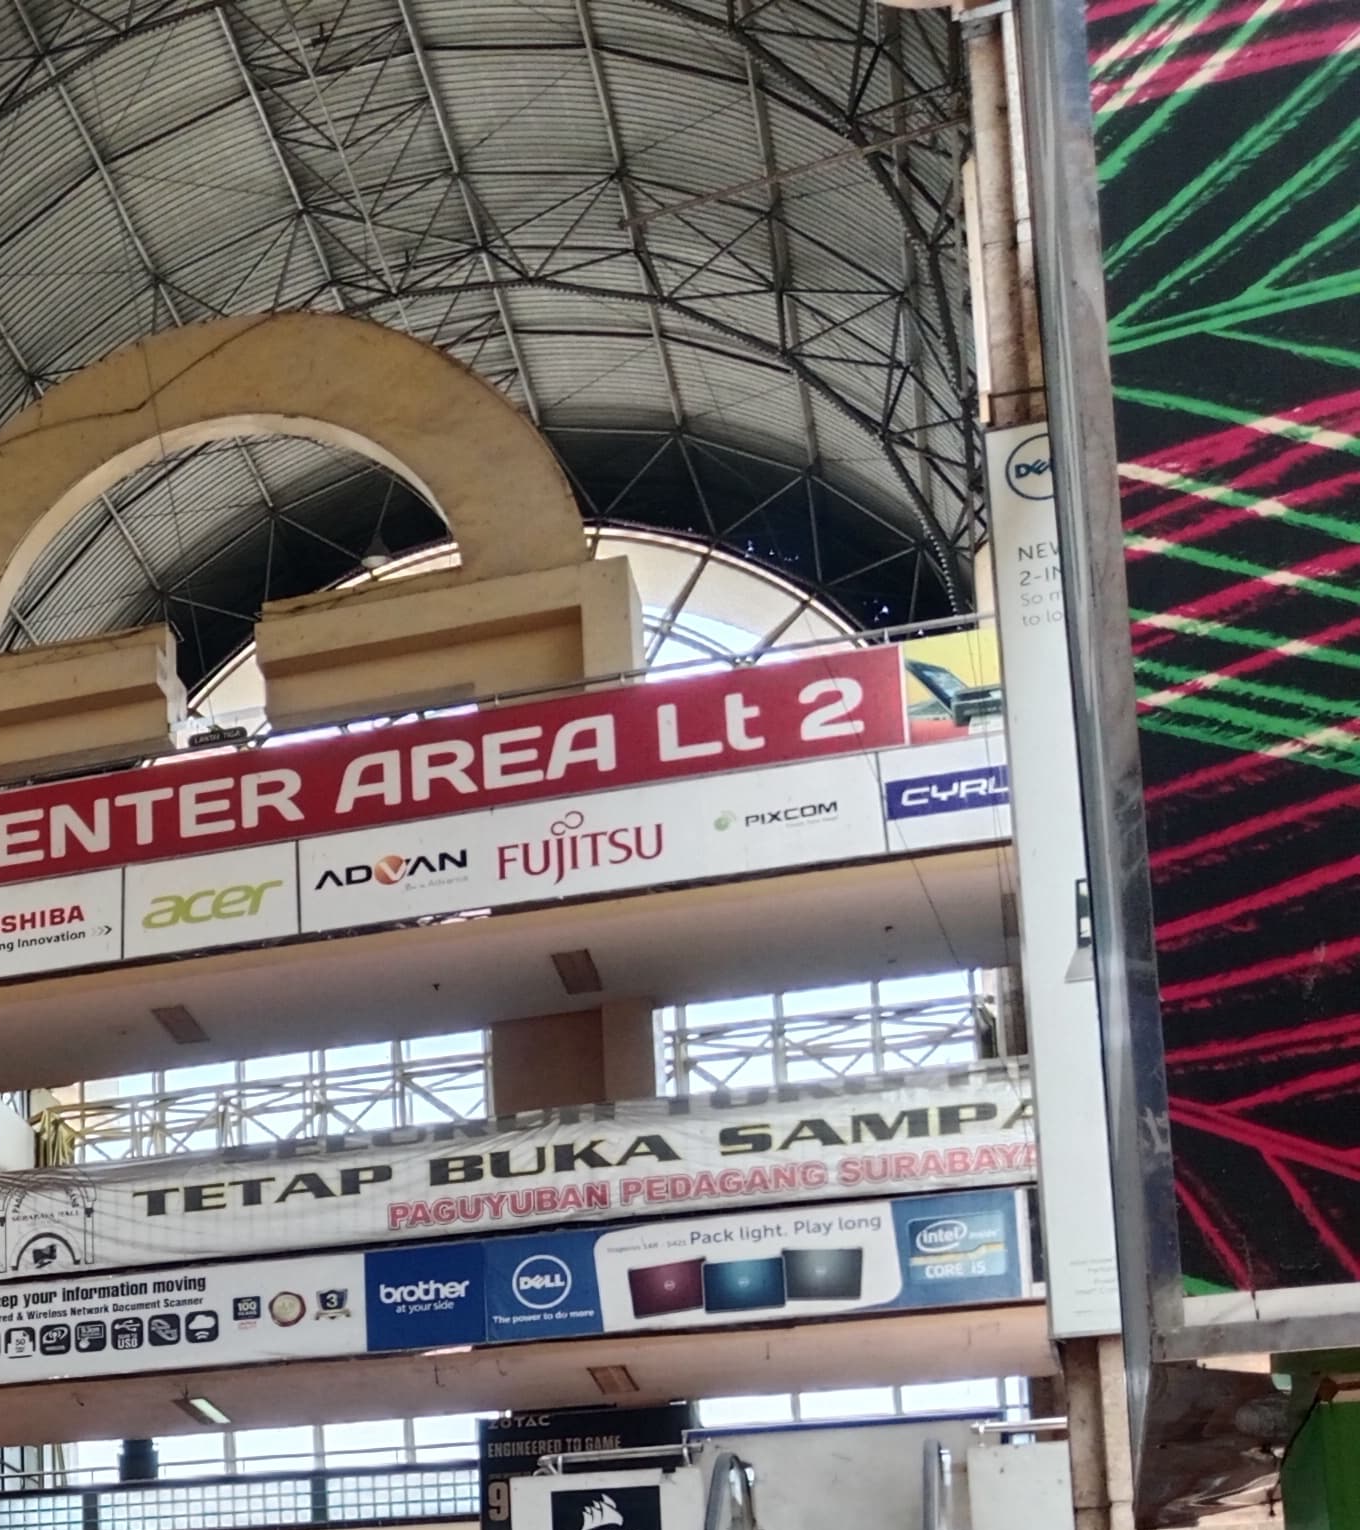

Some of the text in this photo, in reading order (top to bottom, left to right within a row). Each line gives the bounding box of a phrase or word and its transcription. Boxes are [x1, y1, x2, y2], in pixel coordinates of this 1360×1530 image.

[335, 715, 615, 814] AREA
[657, 693, 765, 763] Lt
[800, 676, 865, 741] 2
[745, 801, 838, 827] PIXCOM
[497, 820, 664, 885] FUJITSU
[315, 849, 467, 890] ADVAN
[142, 880, 283, 928] acer
[17, 930, 86, 951] Innovation
[132, 1165, 393, 1217] TETAP
[428, 1134, 682, 1188] BUKA
[388, 1182, 611, 1231] PAGUYUBAN
[621, 1160, 829, 1204] PEDAGANG
[689, 1228, 734, 1246] Pack
[793, 1218, 832, 1238] Play
[838, 1213, 882, 1234] long
[519, 1273, 565, 1289] DELL
[925, 1262, 963, 1279] CORE
[22, 1290, 58, 1308] your
[61, 1281, 148, 1304] information
[152, 1275, 207, 1297] moving
[379, 1279, 470, 1305] brother
[25, 1305, 68, 1320] Wireless
[70, 1302, 110, 1316] Network
[408, 1299, 455, 1314] your side
[511, 1312, 542, 1324] power
[488, 1435, 621, 1458] ENGINEERED TO GAME
